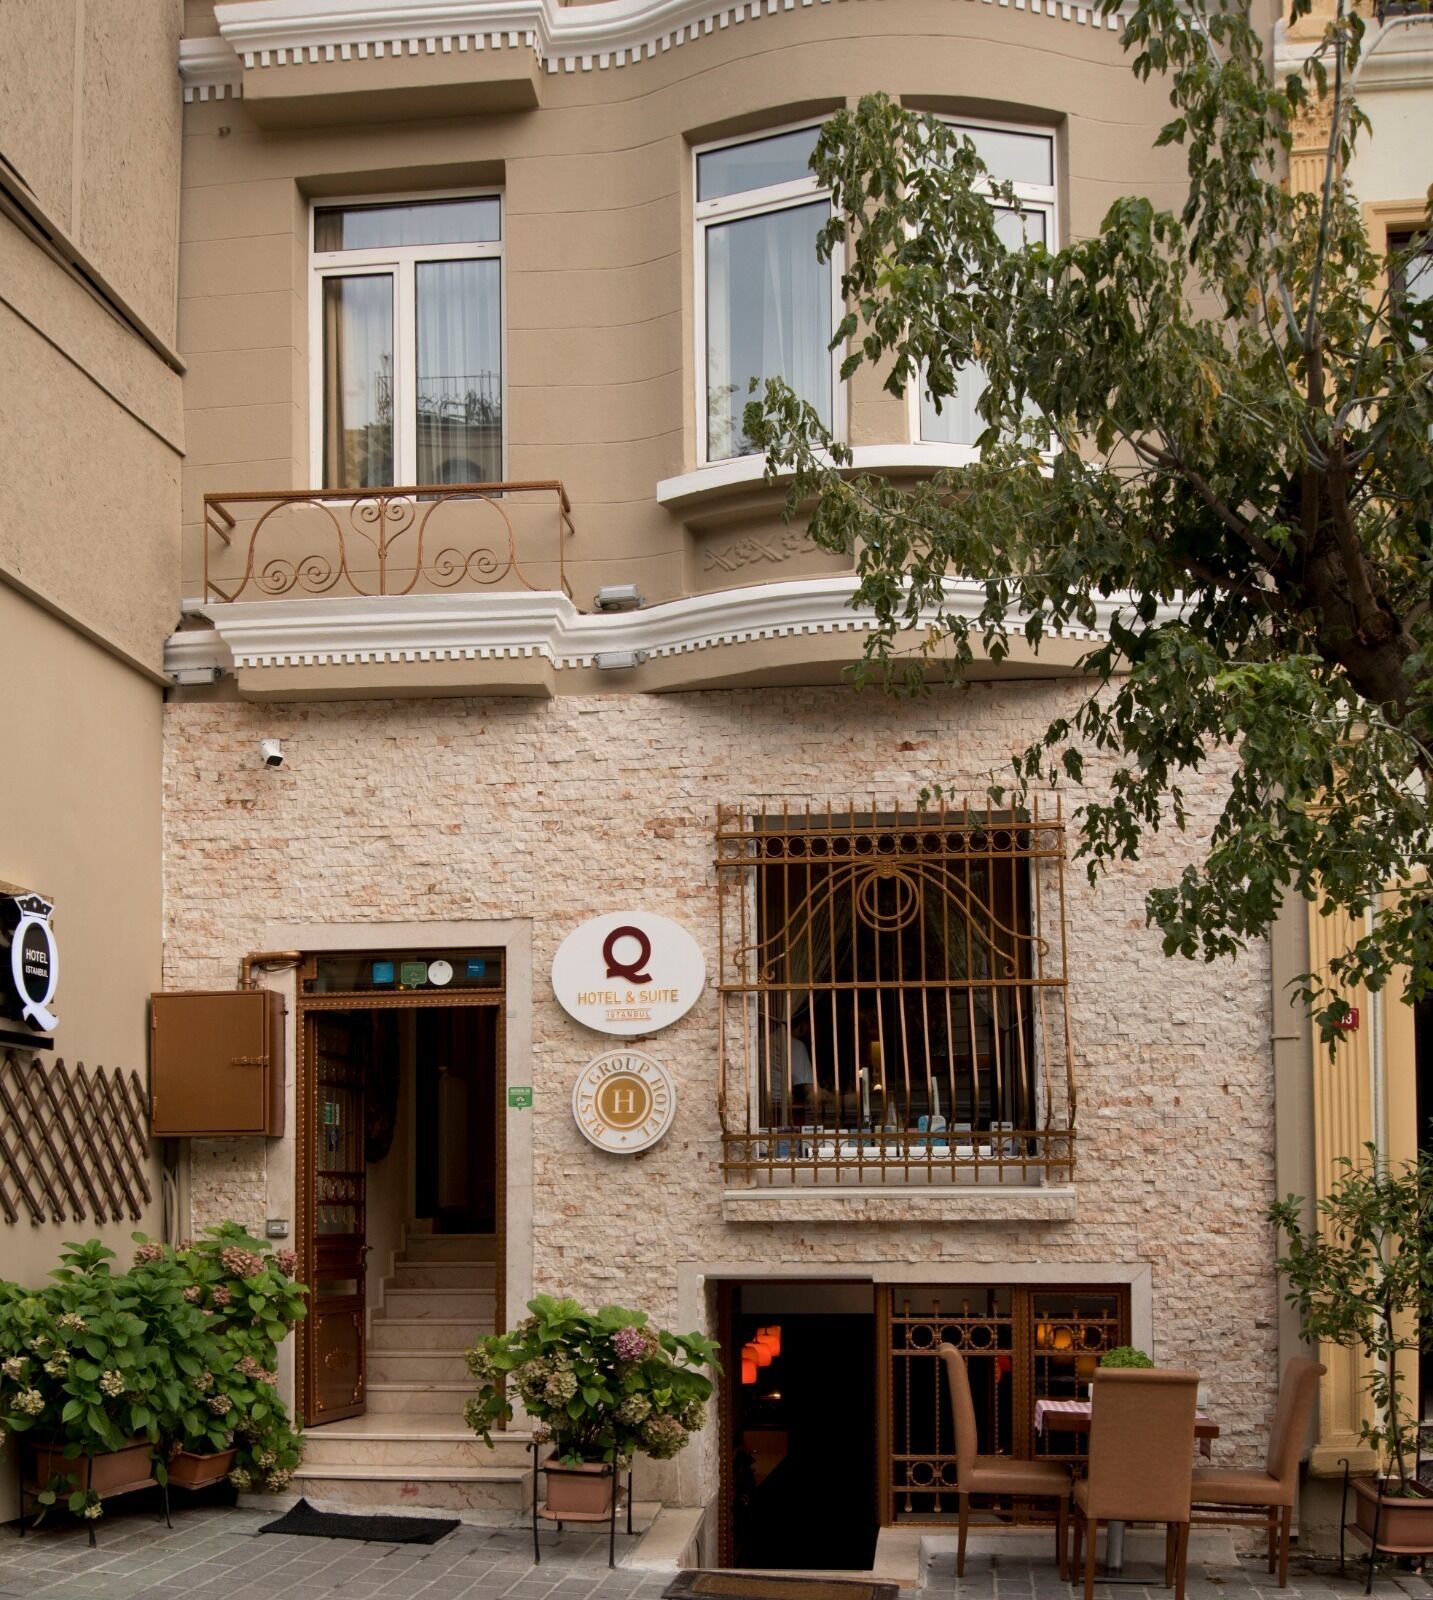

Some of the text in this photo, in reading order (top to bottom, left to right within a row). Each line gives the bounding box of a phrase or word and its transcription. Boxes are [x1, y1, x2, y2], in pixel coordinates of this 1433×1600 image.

[25, 948, 48, 964] HOTEL
[602, 925, 653, 984] Q
[25, 965, 48, 978] ISTANBUL
[577, 989, 679, 1005] HOTEL & SUITE
[581, 1057, 667, 1137] BEST GROUP HOTEL
[611, 1088, 636, 1114] H
